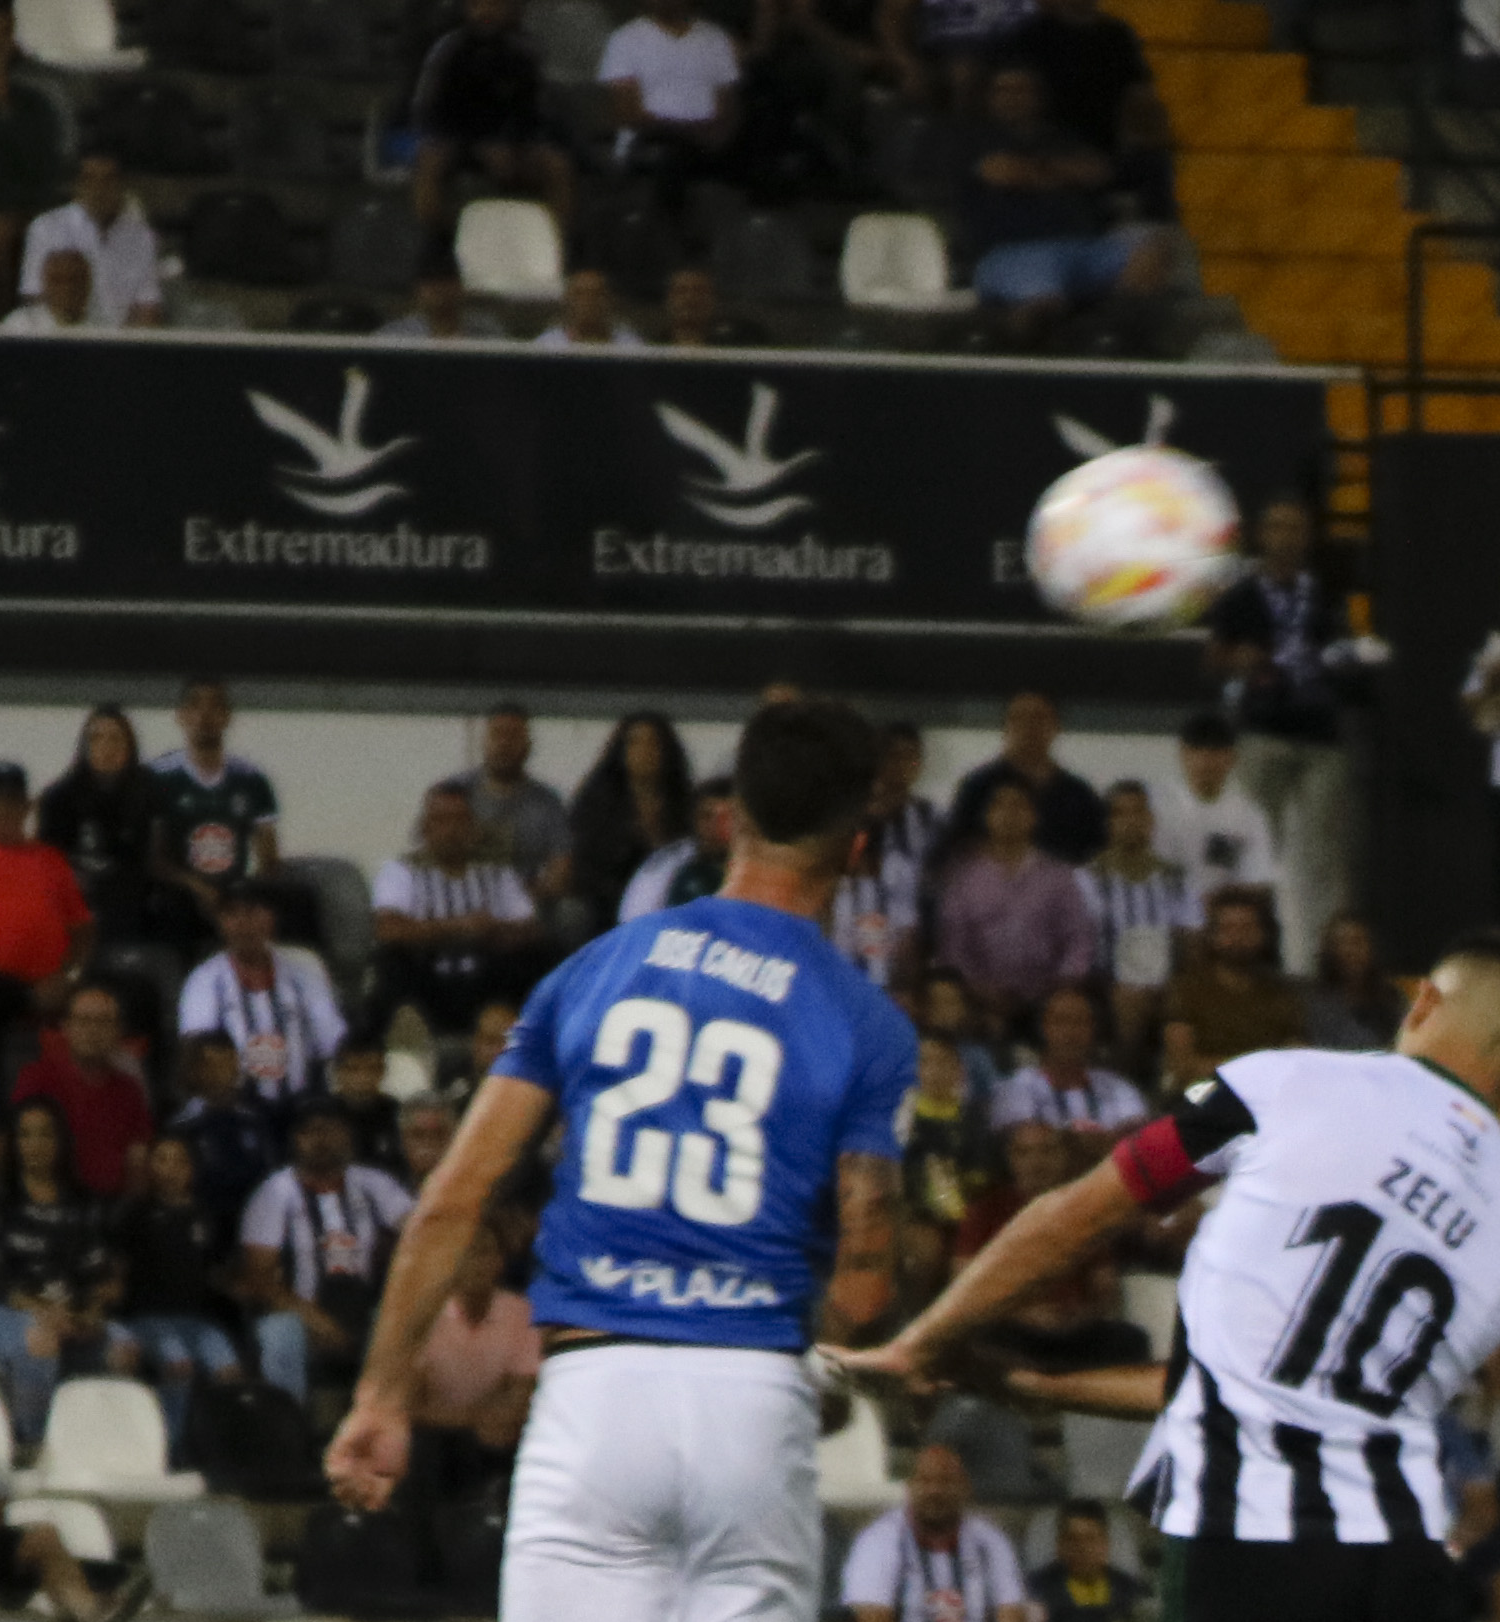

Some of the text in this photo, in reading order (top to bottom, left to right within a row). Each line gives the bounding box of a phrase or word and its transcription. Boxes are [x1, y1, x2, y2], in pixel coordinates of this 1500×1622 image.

[183, 517, 489, 571] Extremadura
[592, 528, 894, 582] Extremadura
[578, 998, 784, 1226] 23
[1376, 1156, 1480, 1250] ZELU
[1264, 1200, 1458, 1420] 10
